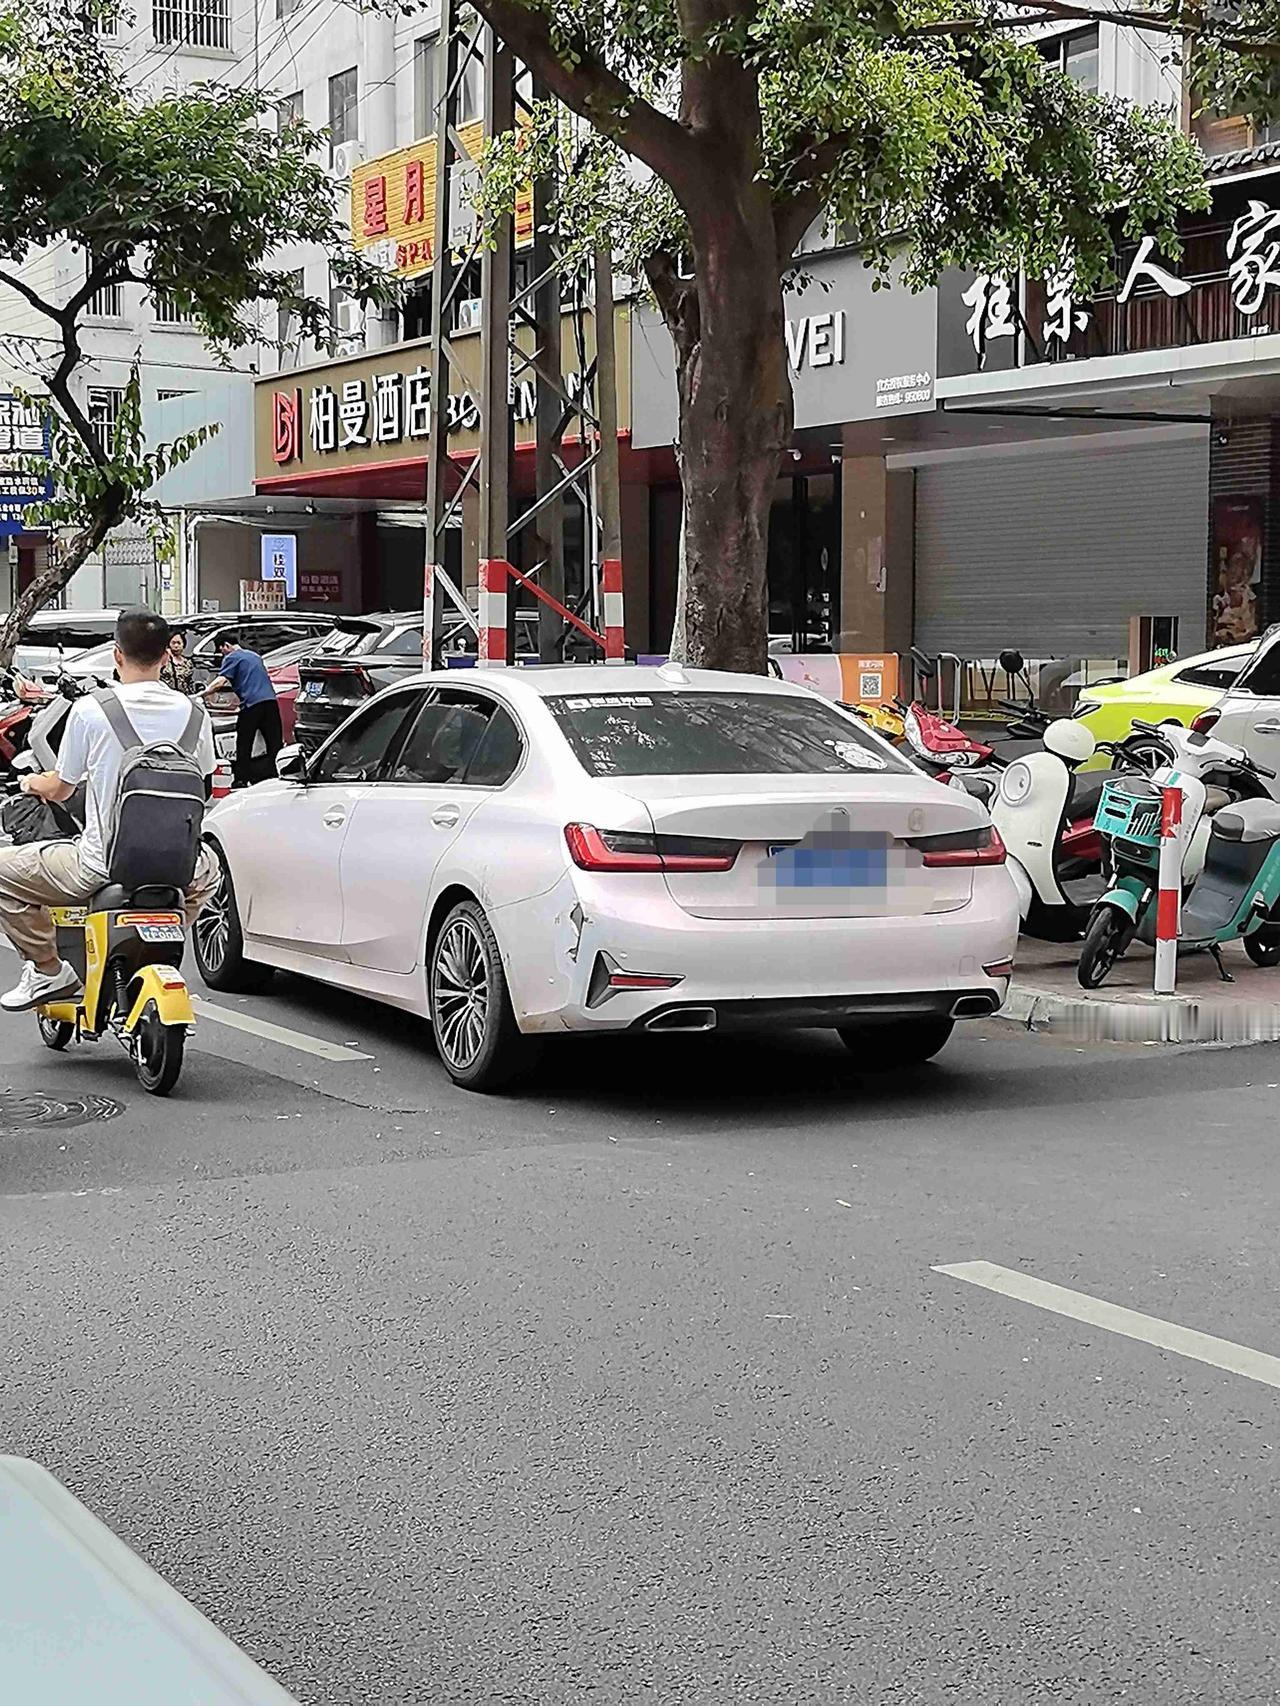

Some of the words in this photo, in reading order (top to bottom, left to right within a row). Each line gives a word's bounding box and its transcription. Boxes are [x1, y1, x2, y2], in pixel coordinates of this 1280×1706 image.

[396, 237, 435, 269] SPA
[309, 365, 432, 453] 柏曼酒店
